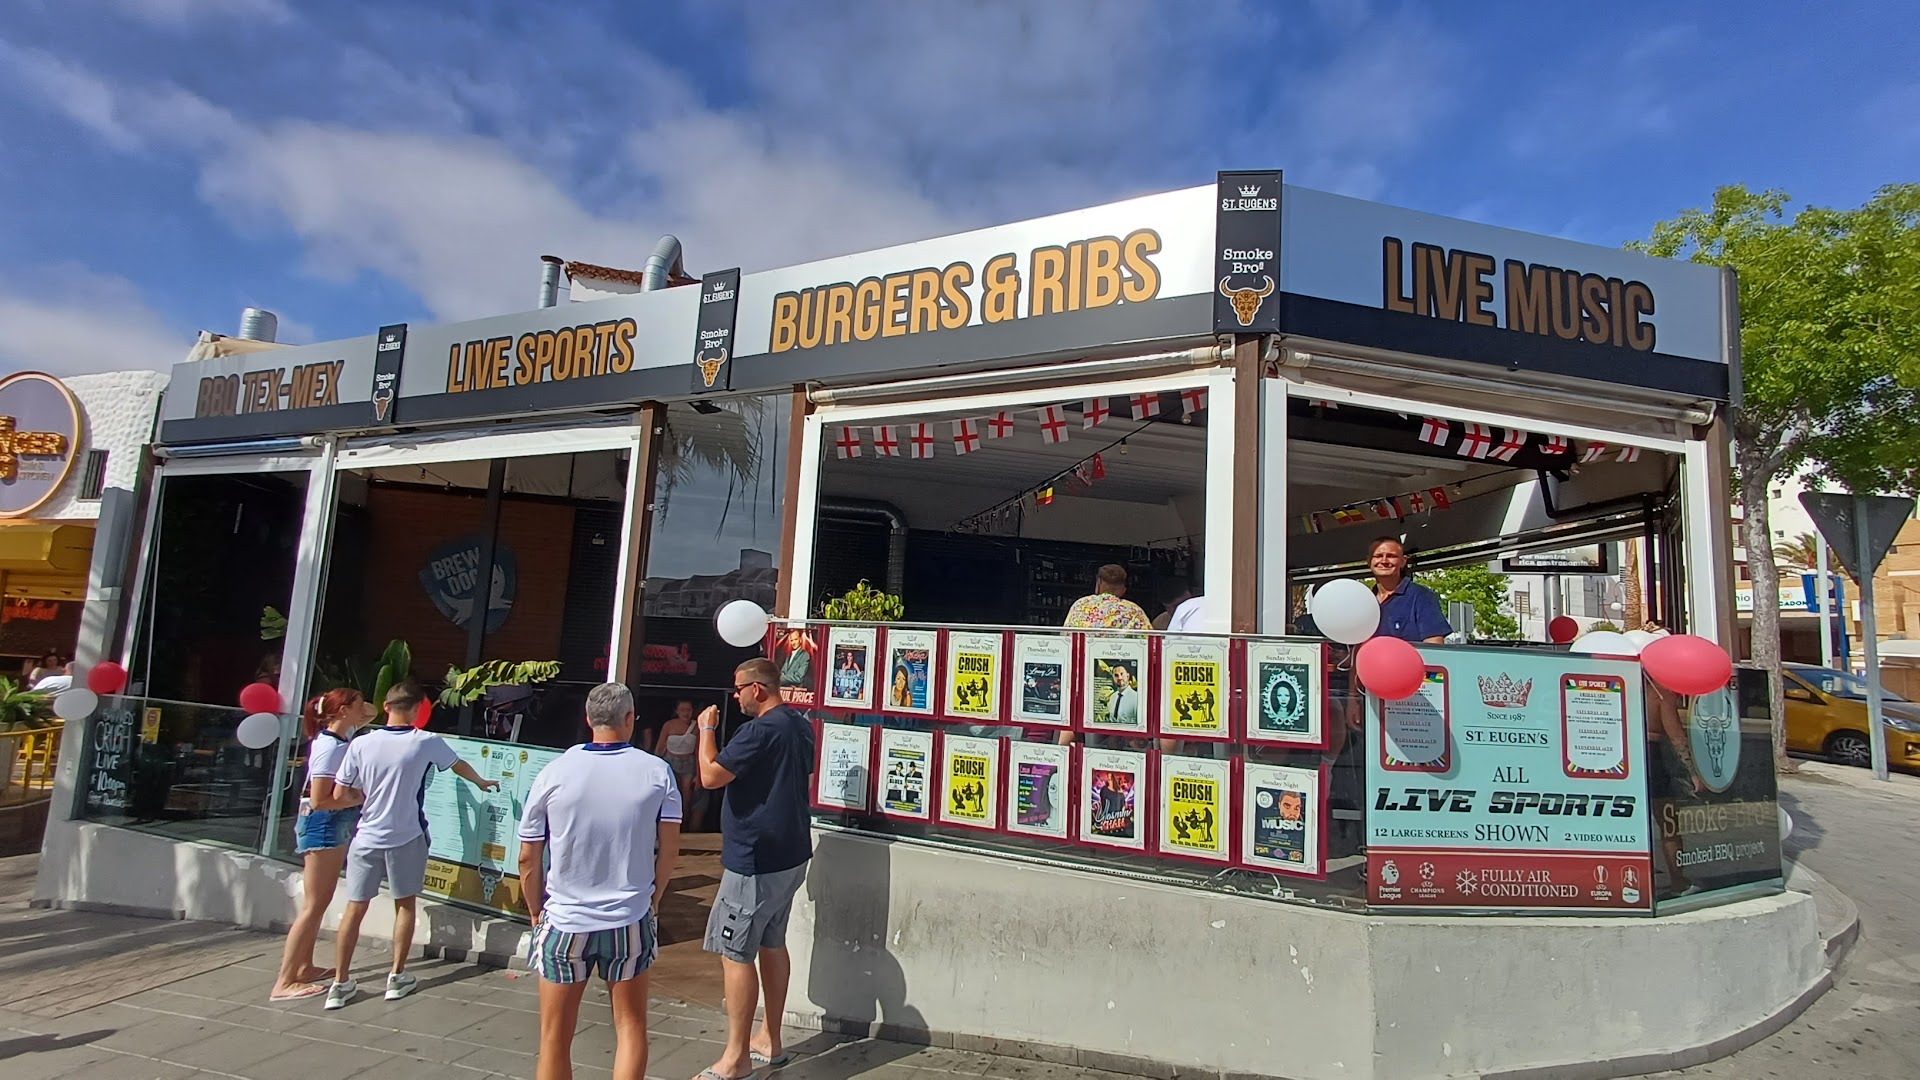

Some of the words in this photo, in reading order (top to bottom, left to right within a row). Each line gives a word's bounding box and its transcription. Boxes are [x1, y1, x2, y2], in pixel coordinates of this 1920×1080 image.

[1223, 248, 1274, 261] Smoke
[769, 261, 973, 353] BURGERS
[982, 251, 1020, 325] &
[1029, 228, 1162, 317] RIBS
[1383, 236, 1496, 328] LIVE
[1504, 259, 1655, 353] MUSIC
[700, 328, 729, 340] Smoke
[446, 335, 513, 394] LIVE
[515, 318, 638, 386] SPORTS
[196, 374, 240, 418] BBQ
[242, 359, 344, 414] TEX-MEX
[431, 546, 479, 580] BREW
[958, 656, 989, 672] CRUSH
[1174, 665, 1214, 682] CRUSH
[791, 690, 815, 704] PRICE
[1509, 713, 1526, 722] 1987
[1465, 730, 1485, 742] ST.
[1489, 731, 1548, 744] EUGEN'S
[95, 752, 120, 770] LIVE
[953, 758, 985, 776] CRUSH
[1491, 766, 1529, 784] ALL
[1173, 781, 1213, 801] CRUSH
[1283, 781, 1299, 789] Night
[1374, 787, 1477, 813] LIVE
[1488, 791, 1636, 818] SPORTS
[1261, 818, 1304, 831] MUSIC
[1663, 801, 1728, 838] Smoke
[1374, 828, 1388, 837] 12
[1391, 828, 1424, 838] LARGE
[1425, 829, 1469, 839] SCREENS
[1474, 823, 1550, 843] SHOWN
[1564, 832, 1572, 842] 2
[1573, 833, 1603, 843] VIDEO
[1604, 834, 1636, 843] WALLS
[1676, 846, 1713, 867] Smoked
[1714, 843, 1734, 861] BBQ
[1735, 840, 1765, 860] project
[424, 875, 447, 890] ENU
[1481, 869, 1526, 883] FULLY
[1527, 869, 1551, 883] AIR
[1379, 885, 1401, 893] Premier
[1480, 883, 1579, 898] CONDITIONED
